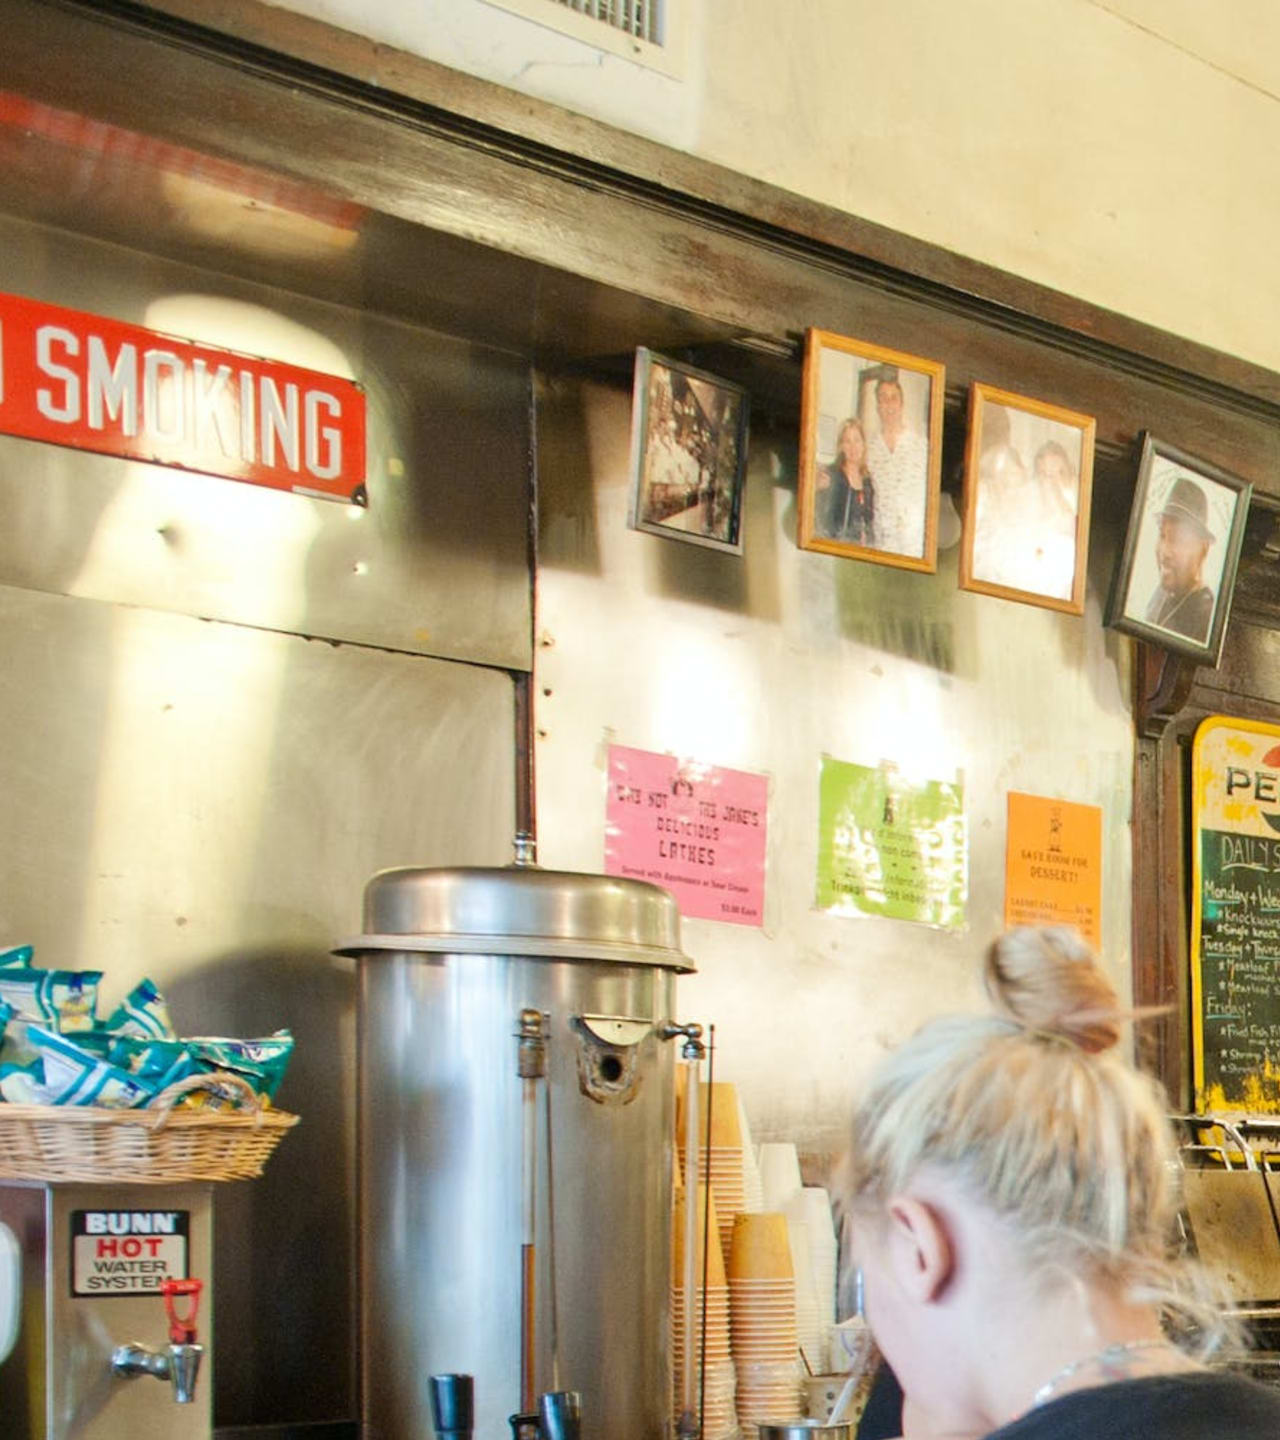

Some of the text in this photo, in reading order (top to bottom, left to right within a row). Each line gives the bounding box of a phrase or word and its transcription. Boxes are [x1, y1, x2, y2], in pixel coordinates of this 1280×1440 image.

[36, 325, 342, 480] SMOKING
[657, 817, 720, 841] DELICIOUS
[659, 840, 716, 866] LATKES
[1221, 836, 1269, 867] DAILY
[1204, 880, 1249, 912] Monday
[1202, 935, 1242, 960] Tuesday
[85, 1213, 174, 1234] BUNN
[96, 1238, 162, 1258] HOT
[94, 1261, 167, 1273] WATER
